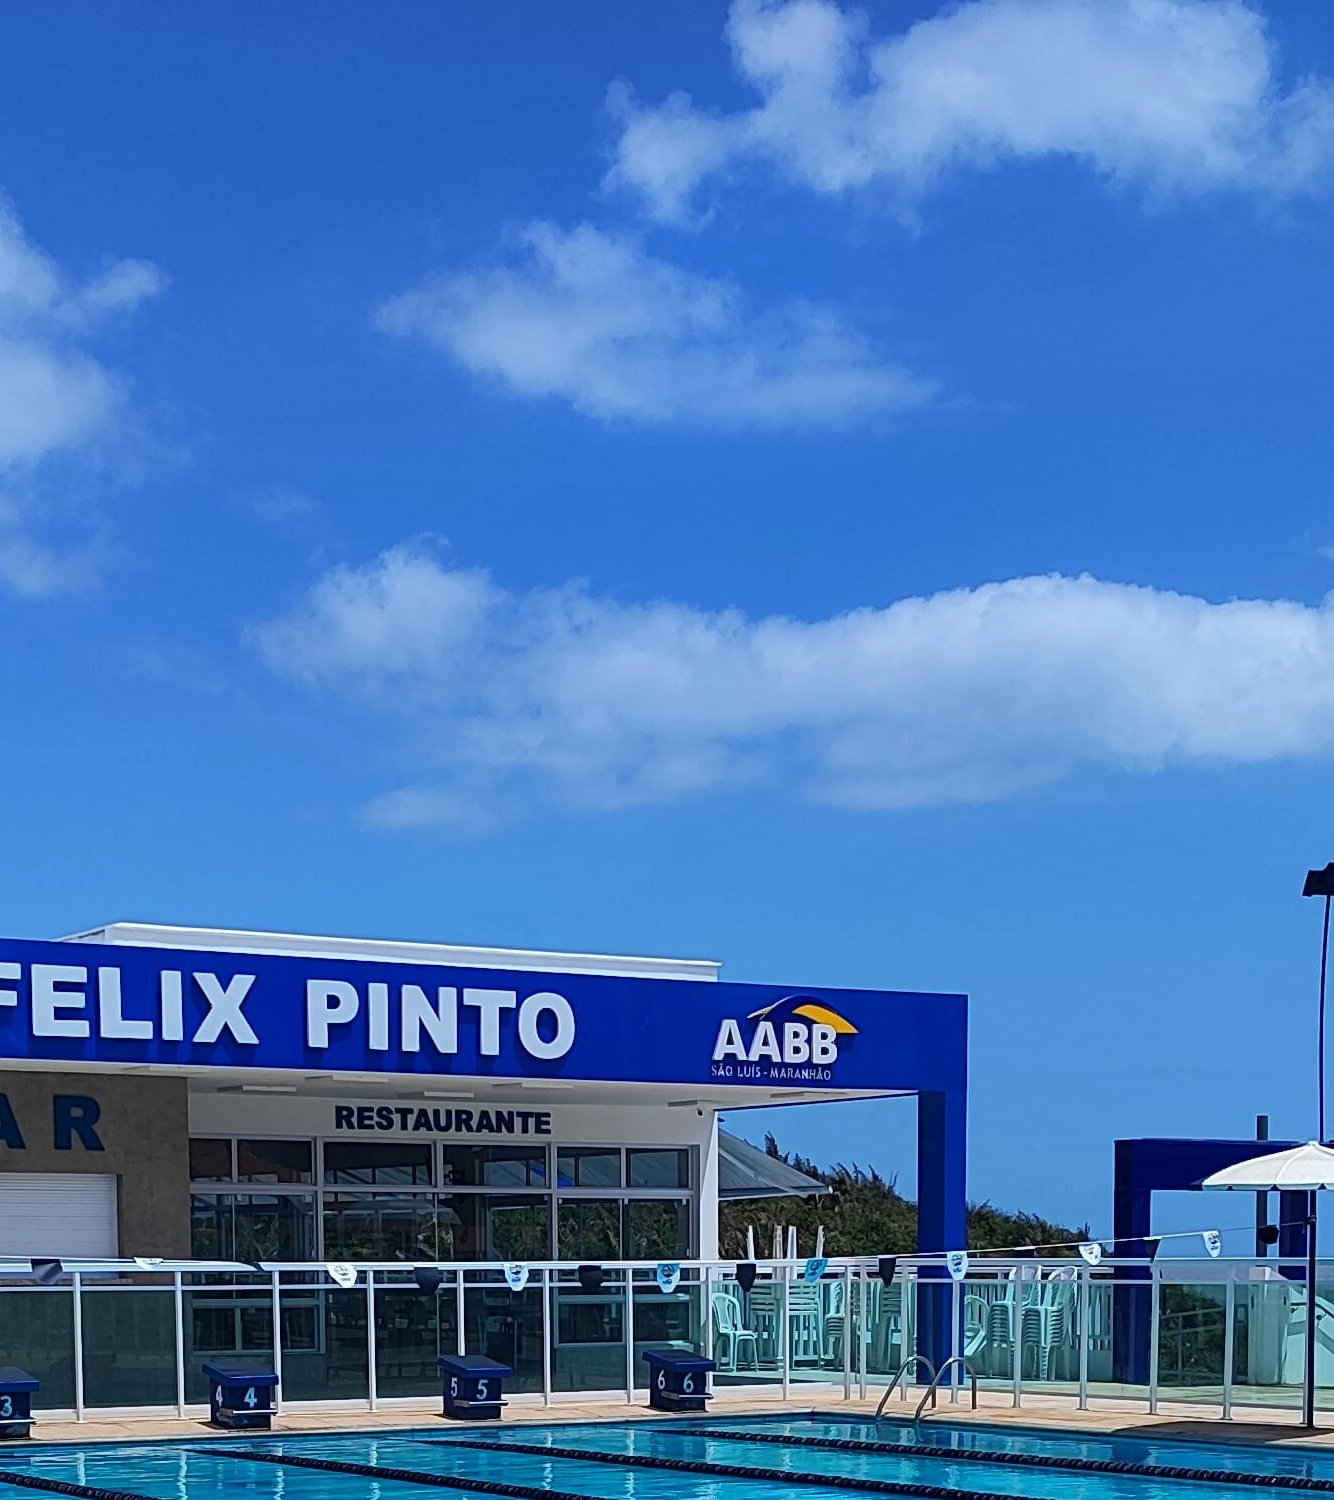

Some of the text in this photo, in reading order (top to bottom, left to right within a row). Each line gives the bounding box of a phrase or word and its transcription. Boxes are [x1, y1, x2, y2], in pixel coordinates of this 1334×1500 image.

[306, 979, 576, 1060] PINTO
[712, 1018, 838, 1065] AABB
[711, 1063, 733, 1077] SÃO
[737, 1064, 761, 1078] LUÍS
[770, 1067, 831, 1081] MARANHÃO
[335, 1105, 552, 1135] RESTAURANTE
[450, 1377, 458, 1397] 5
[476, 1379, 489, 1400] 5
[657, 1369, 666, 1390] 6
[683, 1372, 694, 1393] 6
[0, 1395, 13, 1417] 3
[215, 1385, 224, 1408] 4
[244, 1387, 258, 1408] 4
